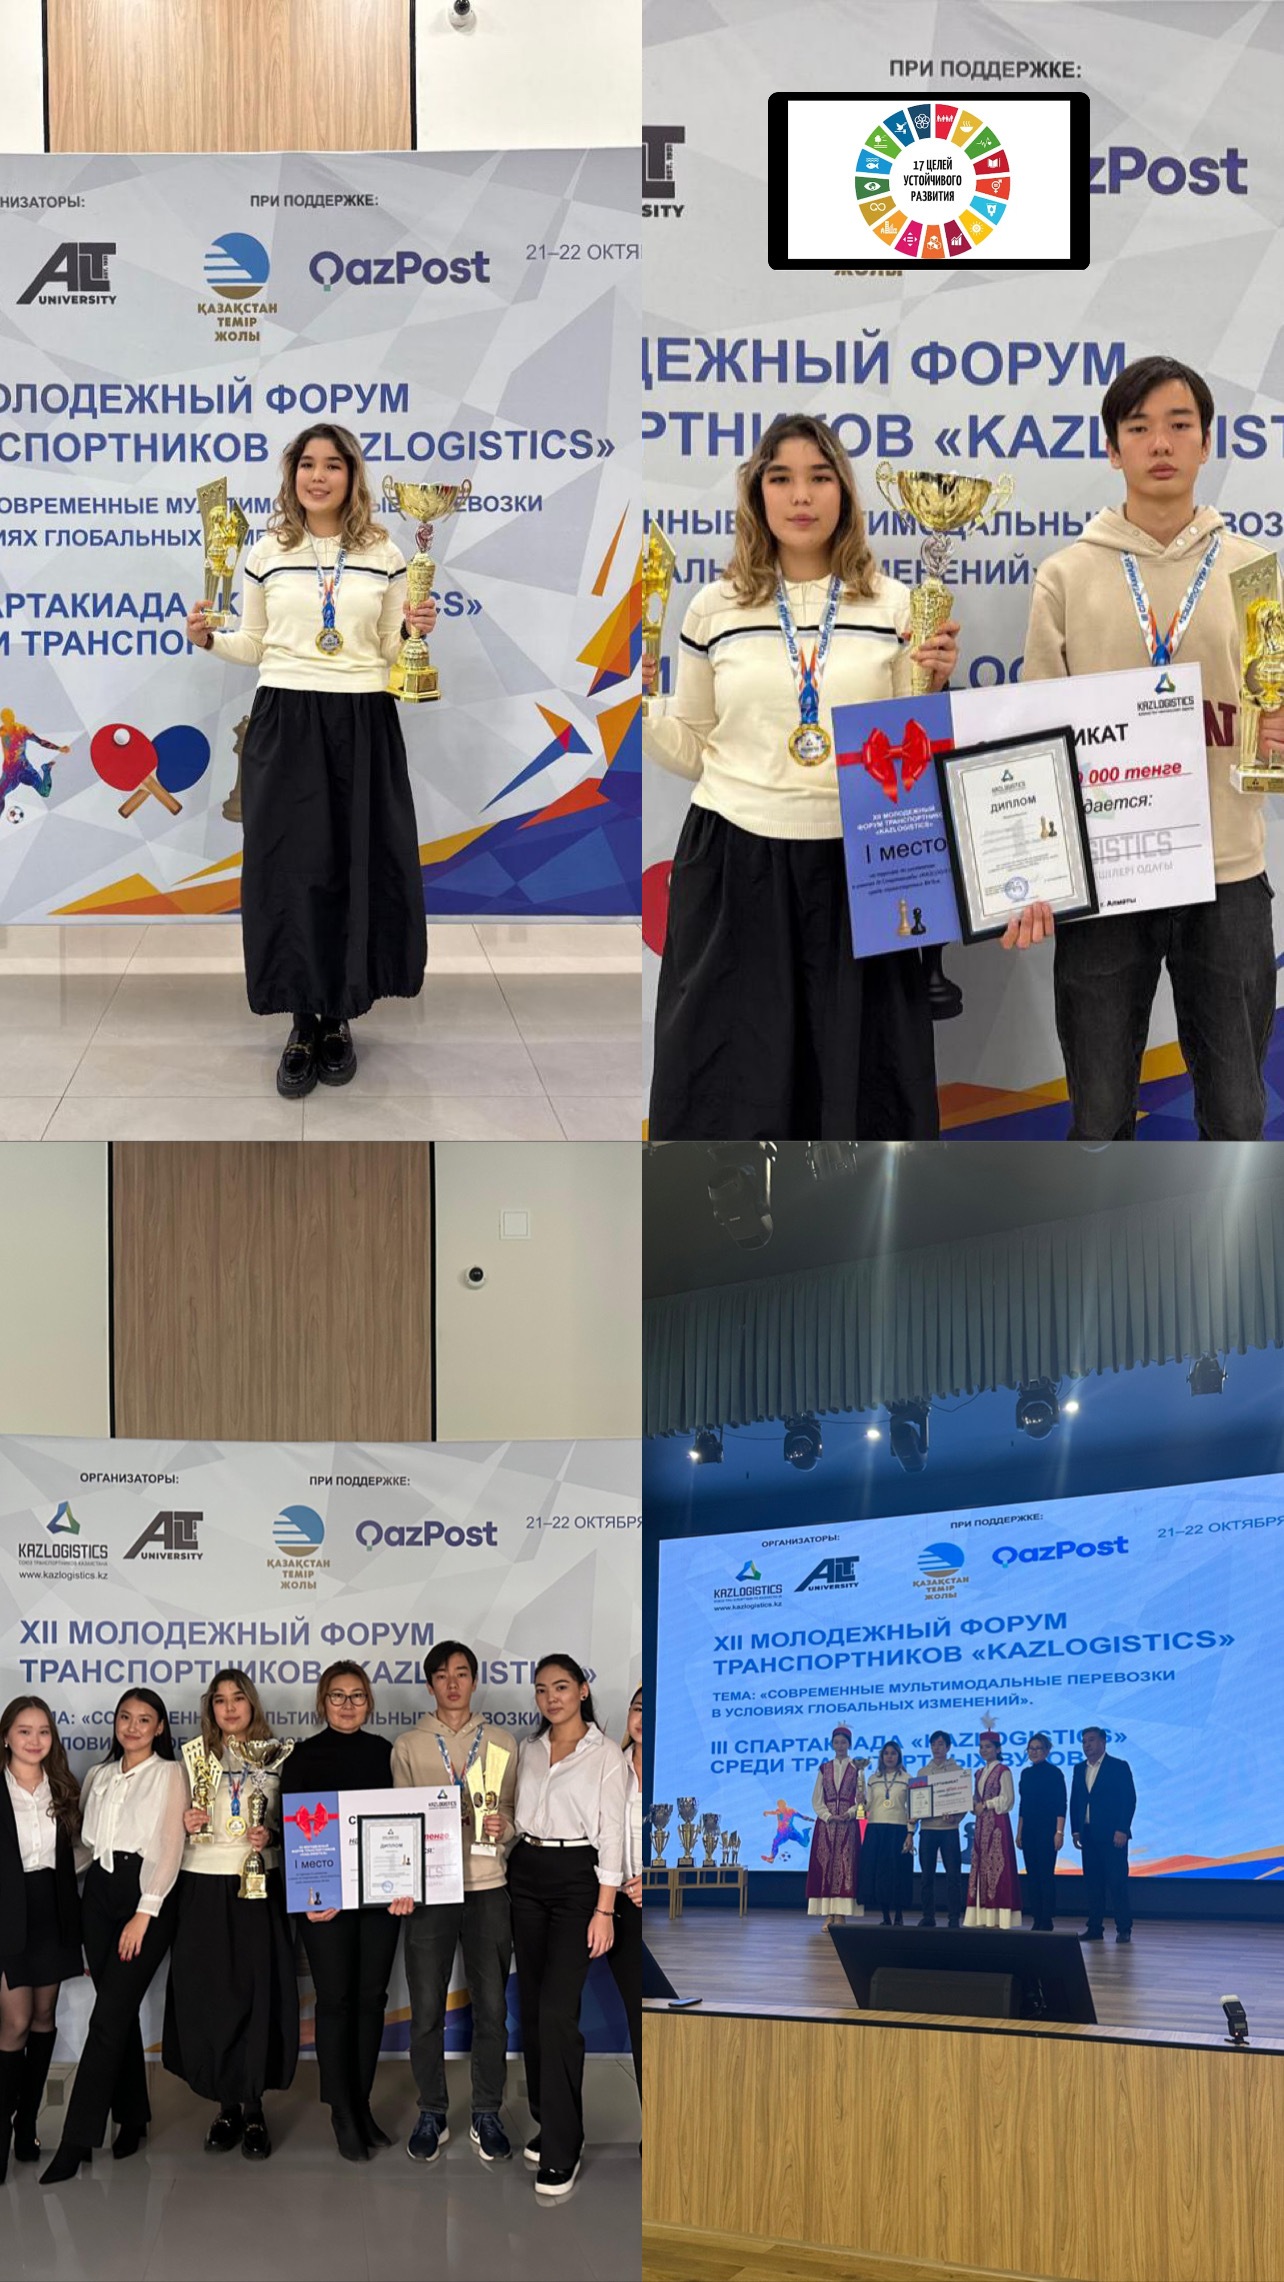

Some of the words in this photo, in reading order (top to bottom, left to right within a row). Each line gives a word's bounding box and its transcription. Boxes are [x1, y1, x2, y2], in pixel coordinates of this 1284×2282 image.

[890, 60, 934, 77] ПРИ
[940, 60, 1082, 81] ПОДДЕРЖКЕ:
[0, 196, 86, 208] НИЗАТОРЫ:
[250, 195, 279, 207] ПРИ
[284, 194, 379, 209] ПОДДЕРЖКЕ:
[587, 243, 642, 260] ОКТЯ
[309, 251, 490, 292] QazPost
[38, 295, 117, 305] UNIVERSITY
[198, 303, 278, 316] ҚАЗАҚСТАН
[217, 317, 257, 327] ТЕМІР
[215, 331, 260, 342] ЖОЛЫ
[642, 328, 889, 390] ЕЖНЫЙ
[911, 341, 1126, 386] ФОРУМ
[266, 383, 409, 414] ФОРУМ
[0, 431, 269, 463] СПОРТНИКОВ
[360, 429, 616, 462] ZLOGISTICS»
[45, 530, 202, 547] ГЛОБАЛЬНЫХ
[0, 592, 188, 623] РТАКИАДА
[1137, 696, 1195, 712] KAZLOGISTICS
[1089, 766, 1120, 785] 000
[1124, 762, 1182, 781] тенге
[990, 795, 1037, 814] ДИПЛОМ
[880, 837, 947, 861] место
[1107, 897, 1137, 907] Алматы
[80, 1472, 180, 1484] ОРГАНИЗАТОРЫ:
[309, 1476, 333, 1486] ПРИ
[336, 1476, 411, 1487] ПОДДЕРЖКЕ:
[950, 1520, 972, 1529] ПРИ
[974, 1513, 1044, 1527] ПОДДЕРЖКЕ:
[355, 1519, 498, 1552] QazPost
[761, 1534, 840, 1548] ОРГАНИЗАТОРЫ:
[18, 1543, 108, 1559] KAZLOGISTICS
[141, 1552, 204, 1560] UNIVERSITY
[992, 1536, 1129, 1569] QazPost
[267, 1558, 330, 1569] ҚАЗАҚСТАН
[19, 1570, 108, 1581] www.kazlogistics.kz
[282, 1570, 314, 1578] ТЕМІР
[912, 1576, 970, 1588] ҚАЗАҚСТАН
[280, 1581, 317, 1590] ЖОЛЫ
[713, 1583, 783, 1599] KAZLOGISTICS
[808, 1582, 860, 1592] UNIVERSITY
[924, 1592, 957, 1601] ЖОЛЫ
[713, 1601, 783, 1611] www.kazlogistics.kz
[20, 1620, 58, 1644] XII
[69, 1615, 310, 1650] МОЛОДЕЖНЫЙ
[320, 1622, 435, 1646] ФОРУМ
[713, 1635, 743, 1652] XII
[751, 1616, 951, 1650] МОЛОДЕЖНЫЙ
[960, 1612, 1068, 1636] ФОРУМ
[713, 1645, 963, 1676] ТРАНСПОРТНИКОВ
[972, 1630, 1236, 1662] «KAZLOGISTICS»
[713, 1690, 756, 1702] ТЕМА:
[759, 1684, 885, 1700] «СОВРЕМЕННЫЕ
[888, 1675, 1062, 1695] МУЛЬТИМОДАЛЬНЫЕ
[1067, 1669, 1176, 1686] ПЕРЕВОЗКИ
[712, 1708, 722, 1718] В
[725, 1704, 804, 1718] УСЛОВИЯХ
[807, 1700, 915, 1715] ГЛОБАЛЬНЫХ
[918, 1692, 1034, 1710] ИЗМЕНЕНИЙ».
[711, 1740, 728, 1755] III
[710, 1757, 785, 1776] СРЕДИ
[301, 1859, 334, 1869] место
